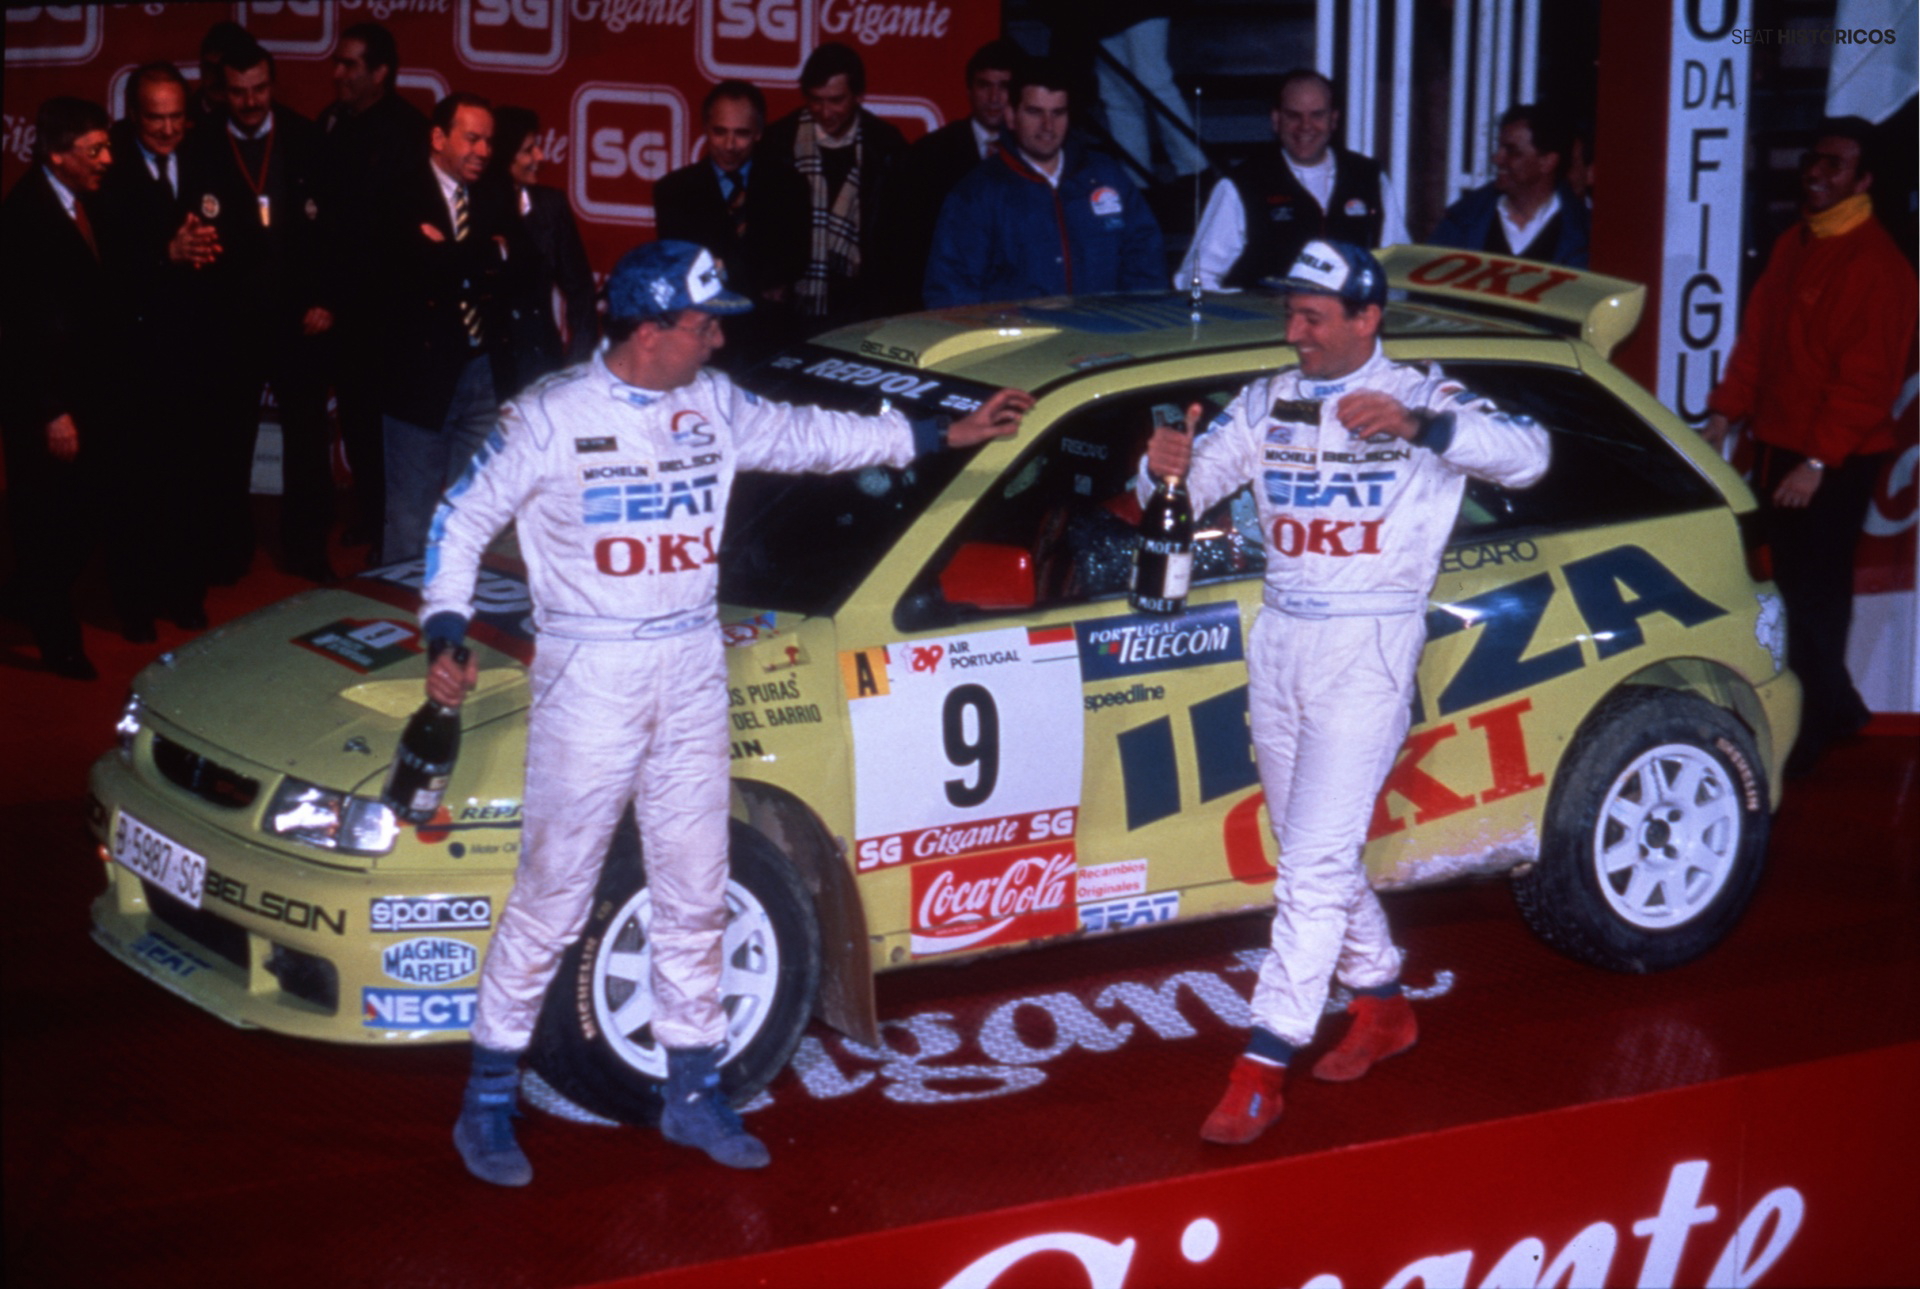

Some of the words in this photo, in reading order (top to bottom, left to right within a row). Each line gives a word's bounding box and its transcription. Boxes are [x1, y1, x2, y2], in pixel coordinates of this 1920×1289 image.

[717, 0, 798, 42] SG
[820, 0, 951, 45] Gigante
[1683, 58, 1736, 110] DA
[590, 127, 668, 178] SG
[1408, 254, 1579, 303] OKI
[860, 340, 921, 364] BELSON
[803, 358, 941, 399] REPSOL
[583, 467, 648, 480] MICHELIN
[658, 453, 722, 472] BELSON
[1323, 450, 1410, 464] BELSON
[584, 475, 718, 524] SEAT
[1264, 471, 1396, 507] SEAT
[1272, 517, 1385, 558] OKI
[1437, 539, 1539, 574] ECARO
[949, 642, 970, 655] AIR
[950, 651, 1020, 670] PORTUGAL
[747, 679, 800, 703] PURAS
[855, 651, 878, 697] A
[731, 711, 765, 730] DEL
[765, 704, 822, 727] BARRIO
[1084, 684, 1165, 711] speedline
[942, 683, 999, 808] 9
[858, 836, 902, 870] SG
[913, 819, 1019, 857] Gigante
[1028, 809, 1074, 841] SG
[918, 852, 1078, 929] Coca-Cola
[1080, 863, 1146, 879] Recambios
[205, 869, 346, 935] BELSON
[371, 900, 490, 931] sparco
[577, 936, 597, 1040] MICHELIN
